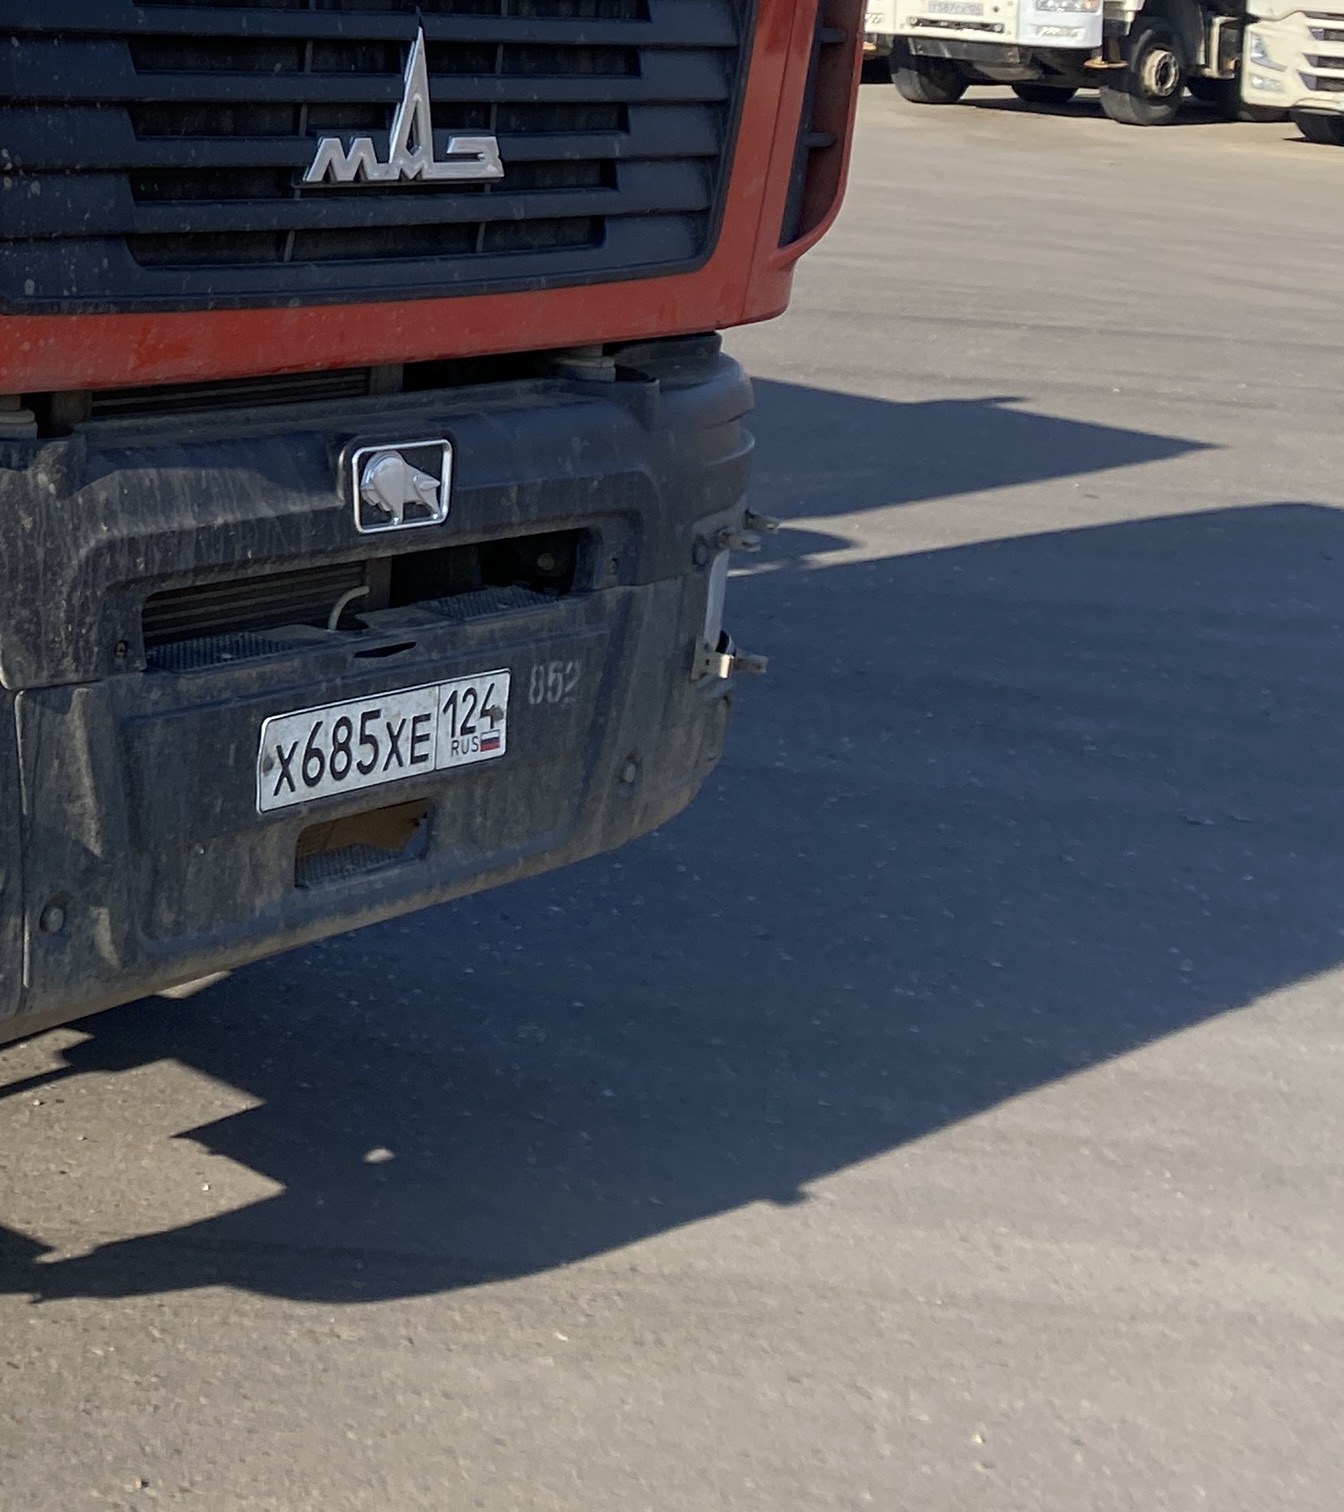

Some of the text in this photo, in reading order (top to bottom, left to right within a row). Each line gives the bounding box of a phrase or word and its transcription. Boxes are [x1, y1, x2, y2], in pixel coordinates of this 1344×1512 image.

[273, 682, 499, 797] Х685ХЕ 124
[450, 736, 479, 758] RUS
